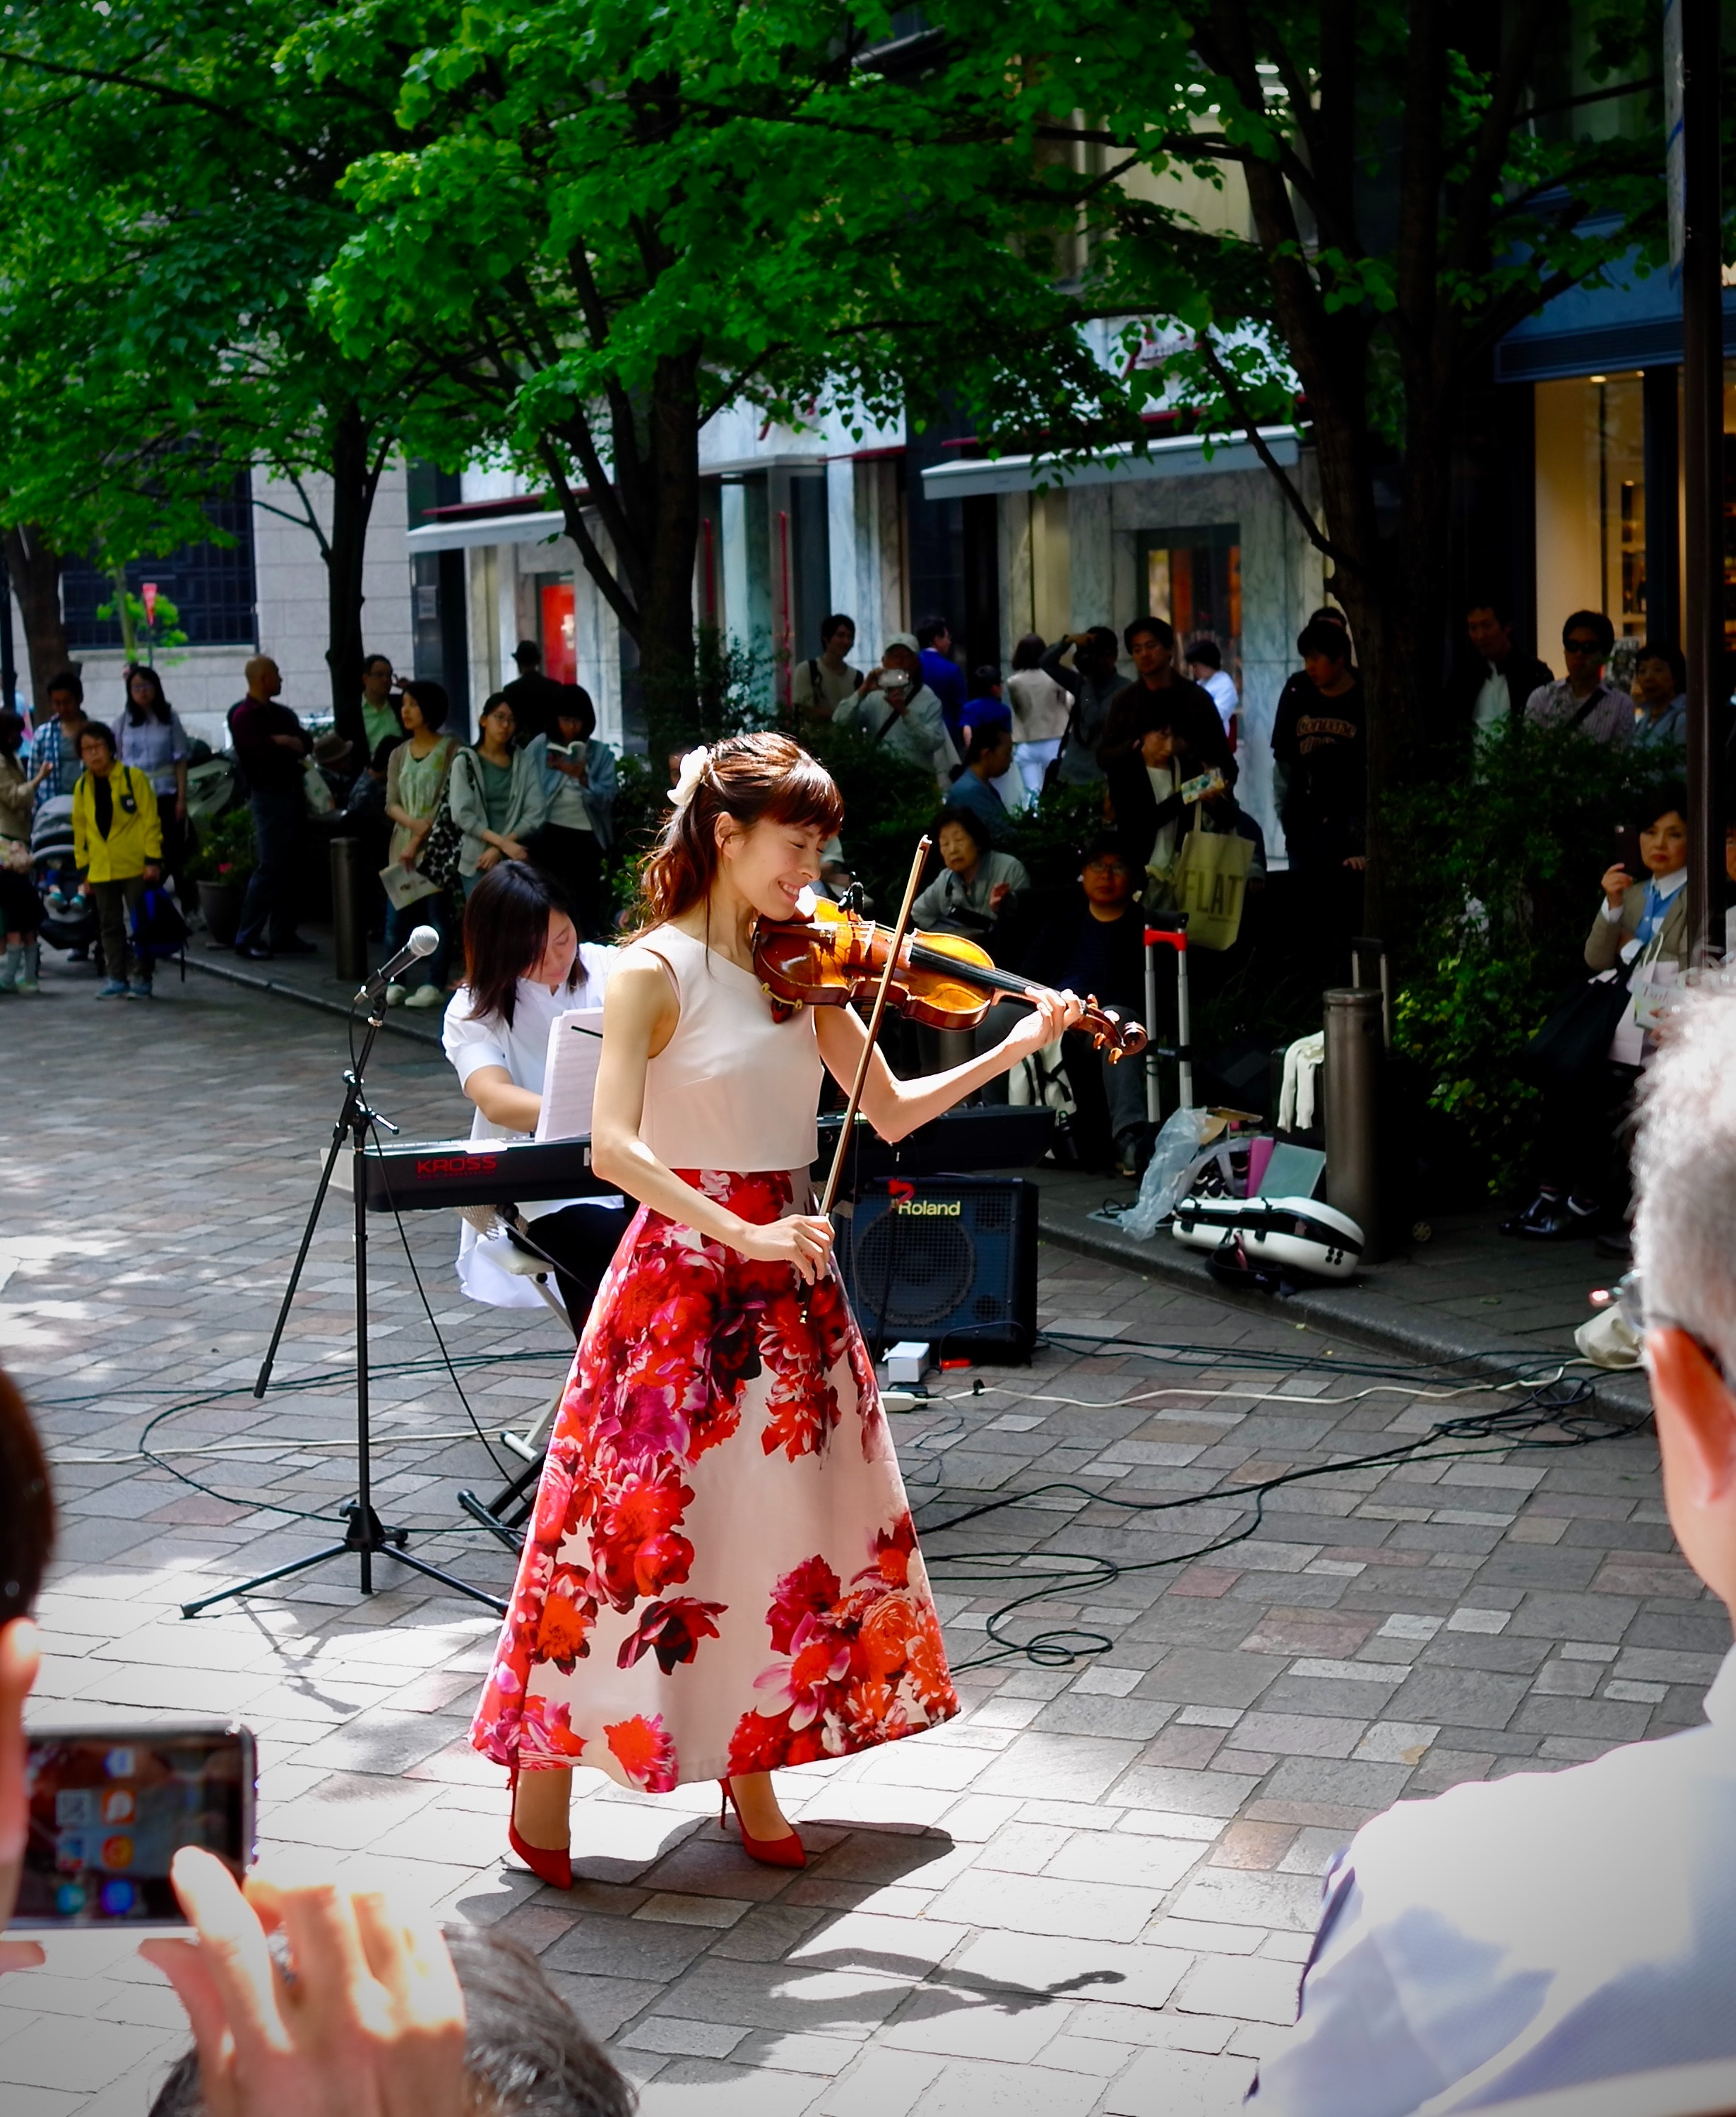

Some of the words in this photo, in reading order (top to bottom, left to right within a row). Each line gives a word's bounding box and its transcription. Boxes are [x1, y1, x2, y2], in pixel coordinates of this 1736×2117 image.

[1179, 870, 1243, 916] FLAT
[416, 1155, 497, 1175] KROSS
[898, 1199, 961, 1216] Roland
